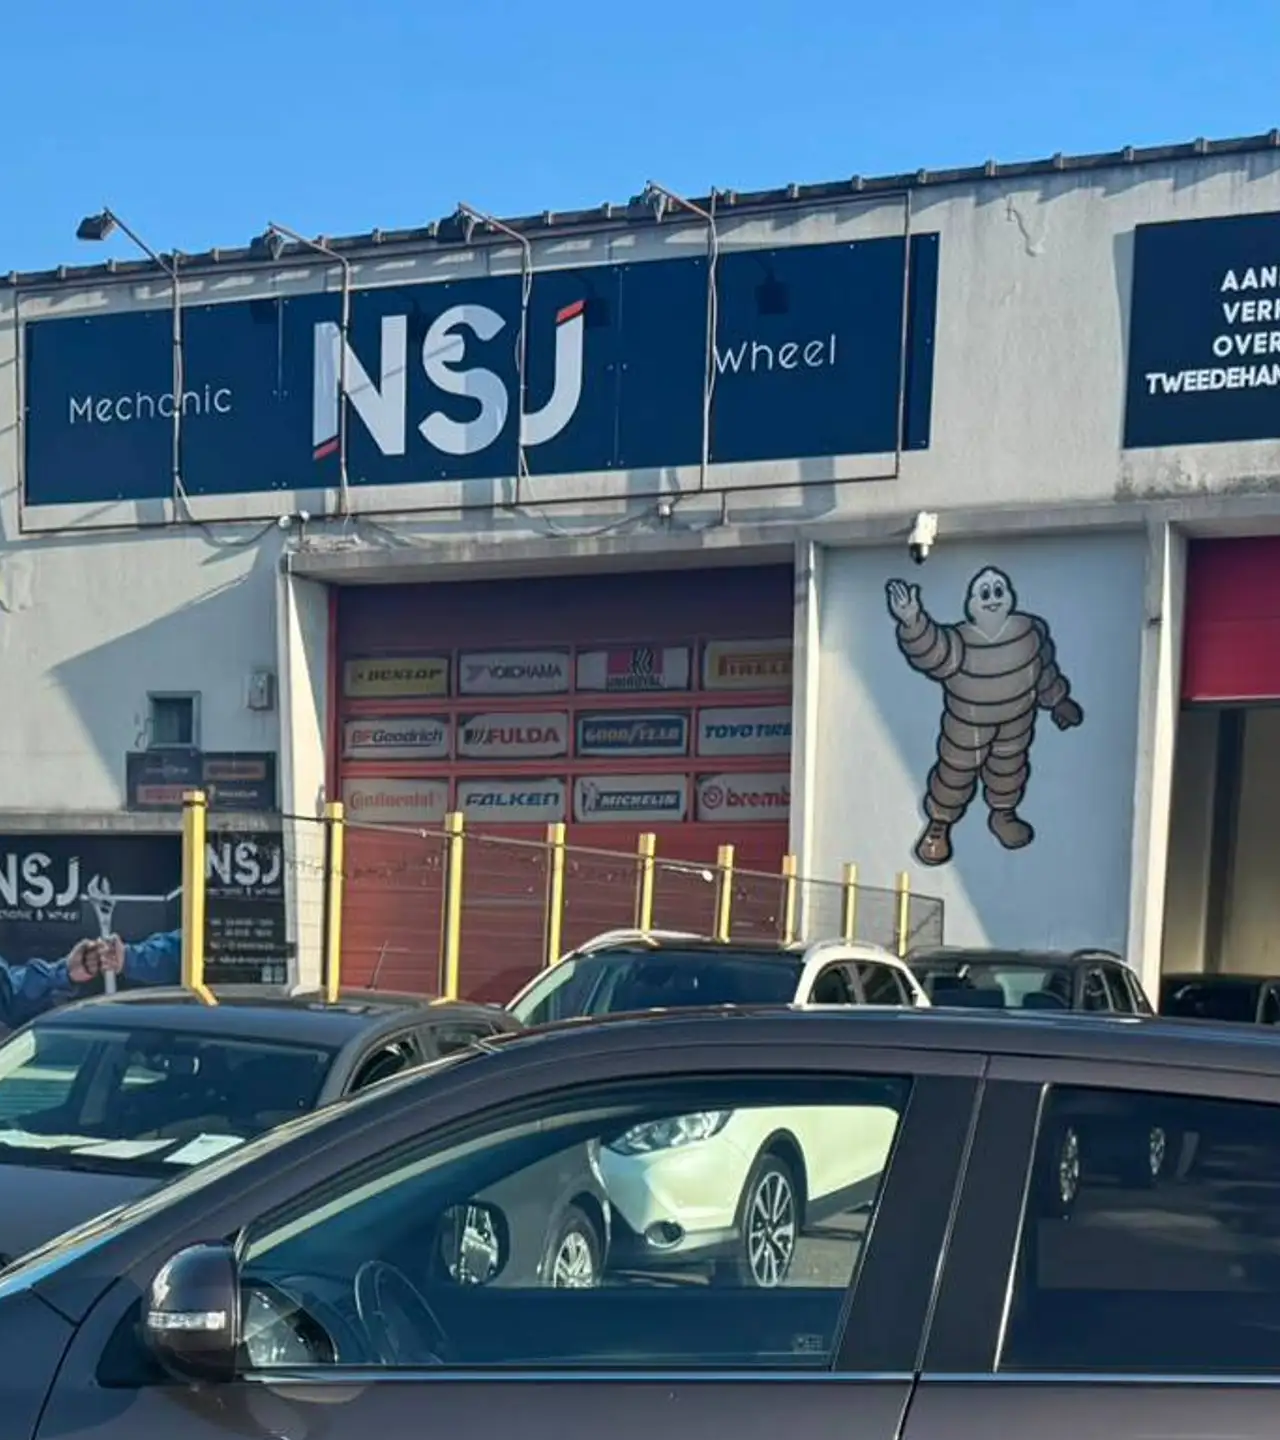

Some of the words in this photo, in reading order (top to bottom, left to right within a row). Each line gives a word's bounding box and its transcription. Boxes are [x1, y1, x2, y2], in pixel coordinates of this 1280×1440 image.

[313, 299, 586, 460] NSJ
[487, 663, 562, 681] YOKOHAMA
[352, 726, 444, 745] BFGoodrich
[490, 726, 561, 745] FULDA
[704, 723, 753, 739] TOYO
[755, 722, 792, 738] TIRE
[600, 792, 679, 808] MICHELIN
[726, 785, 792, 808] bremb
[206, 841, 281, 886] NSJ
